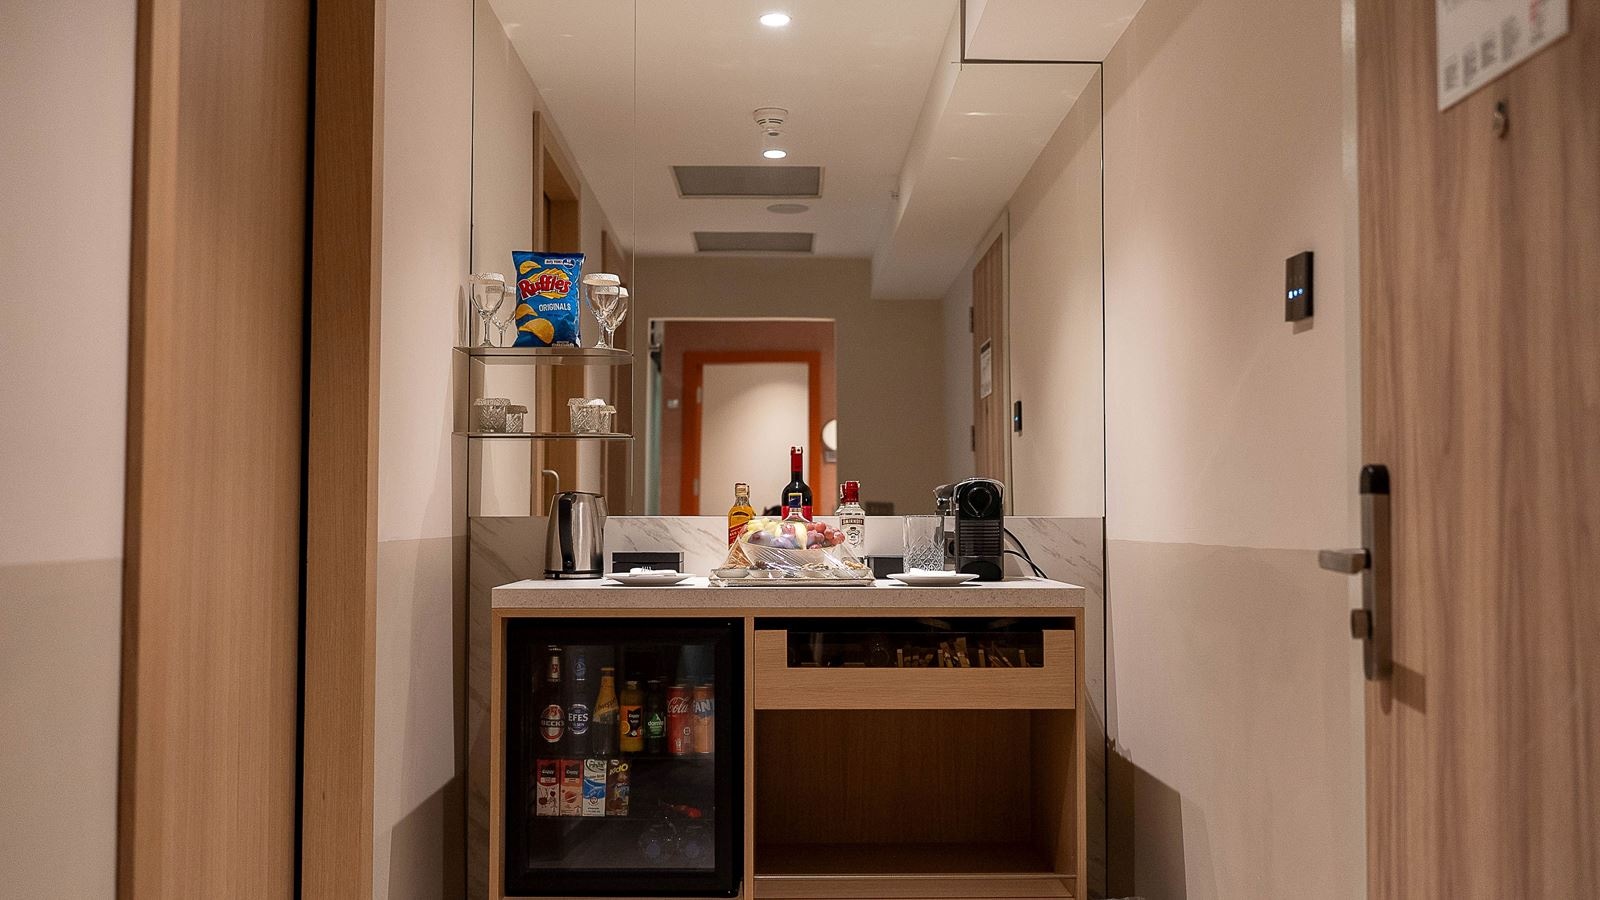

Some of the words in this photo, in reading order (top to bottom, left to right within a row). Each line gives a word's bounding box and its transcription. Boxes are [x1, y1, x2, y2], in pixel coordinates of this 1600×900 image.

[518, 274, 572, 300] Ruffles
[538, 303, 571, 312] ORIGINALS
[568, 712, 589, 722] EFES
